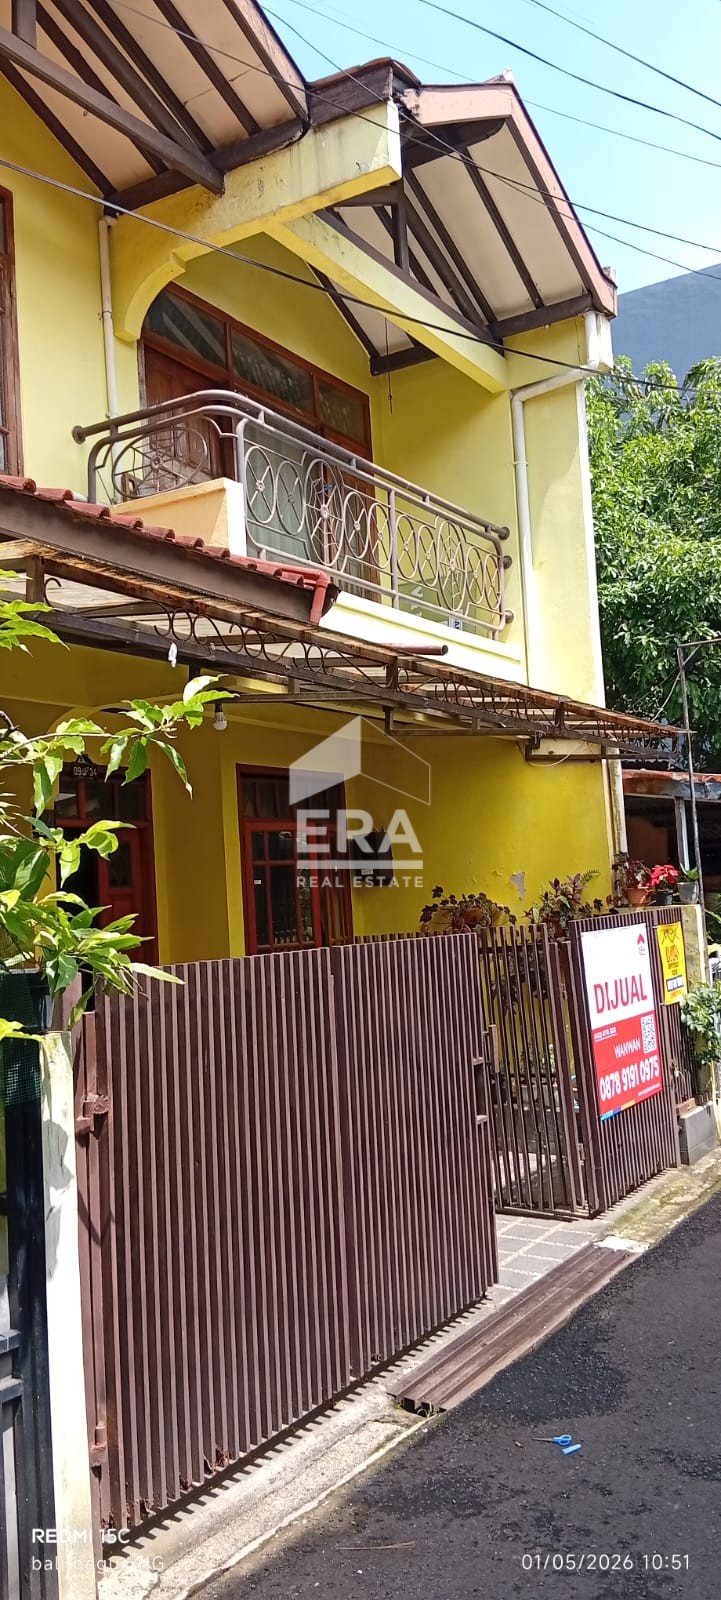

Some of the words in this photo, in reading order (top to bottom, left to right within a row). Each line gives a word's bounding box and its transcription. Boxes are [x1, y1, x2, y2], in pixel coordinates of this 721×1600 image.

[593, 973, 647, 1014] DIJUAL
[600, 1070, 622, 1102] 0878
[621, 1063, 640, 1092] 9191
[639, 1055, 660, 1083] 0975
